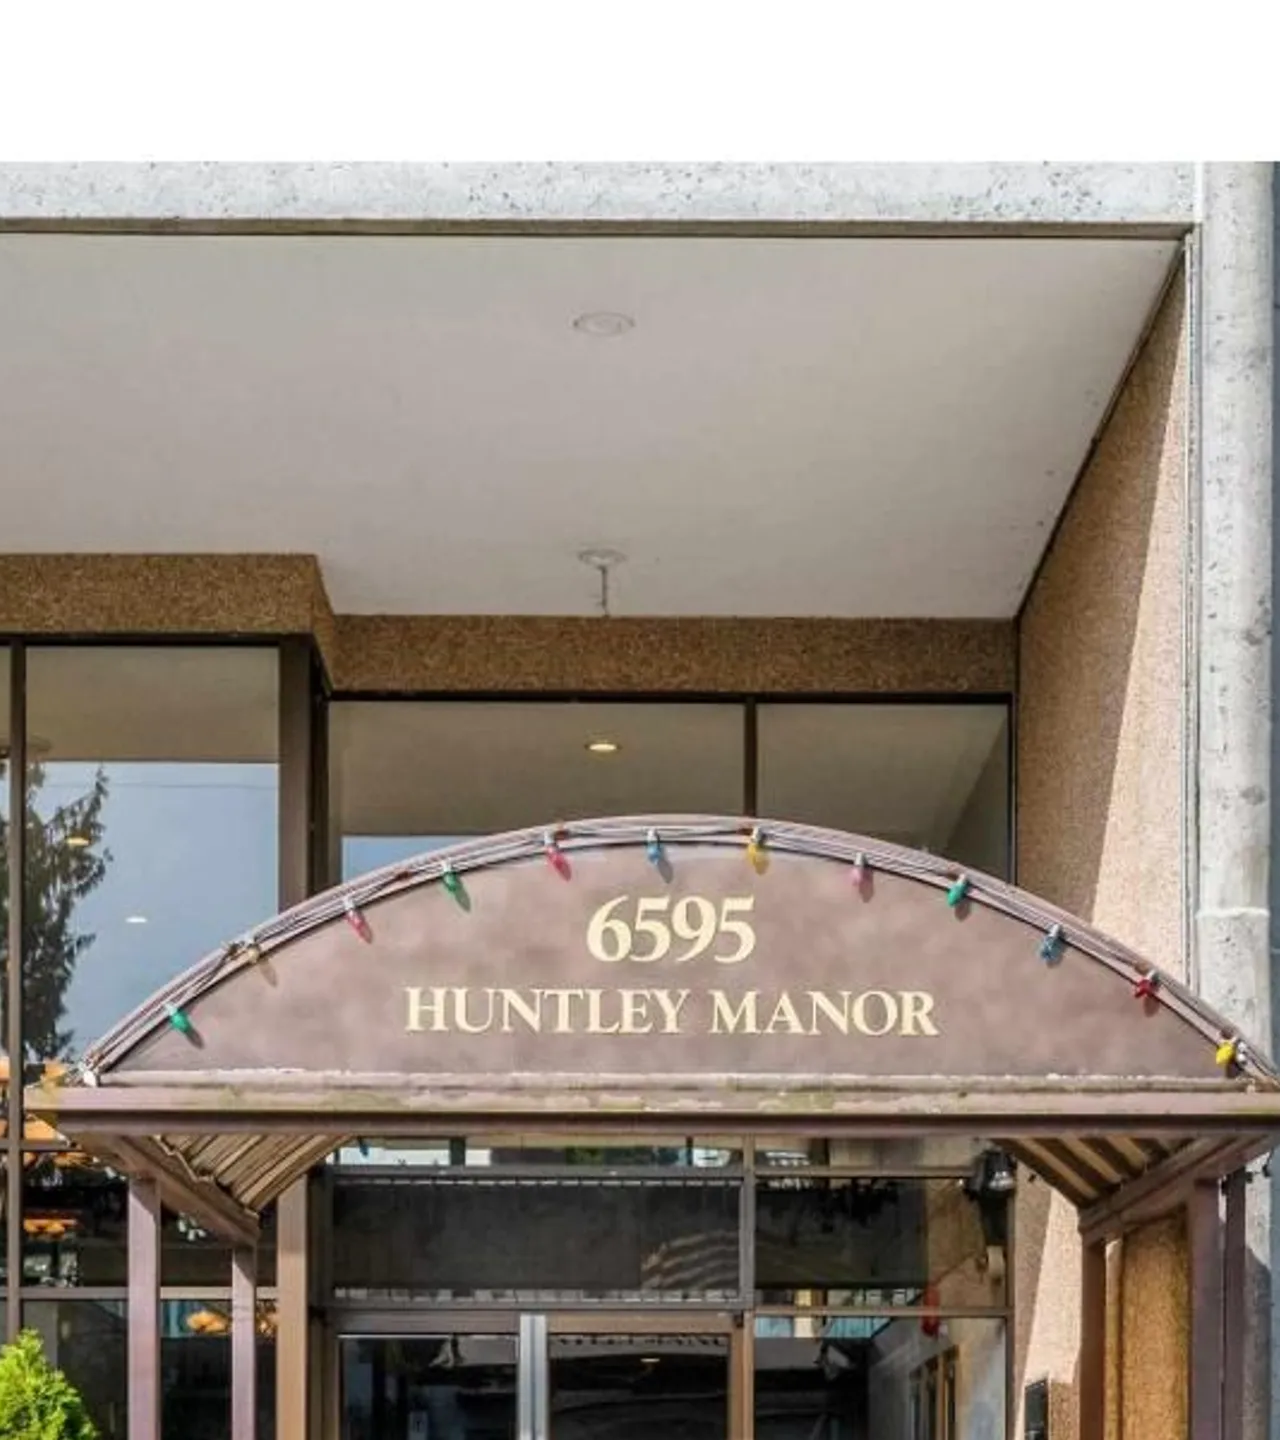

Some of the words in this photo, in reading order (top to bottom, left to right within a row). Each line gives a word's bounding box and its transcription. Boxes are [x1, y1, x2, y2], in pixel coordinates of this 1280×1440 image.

[586, 894, 757, 963] 6595
[405, 986, 691, 1035] HUNTLEY
[711, 989, 939, 1037] MANOR
